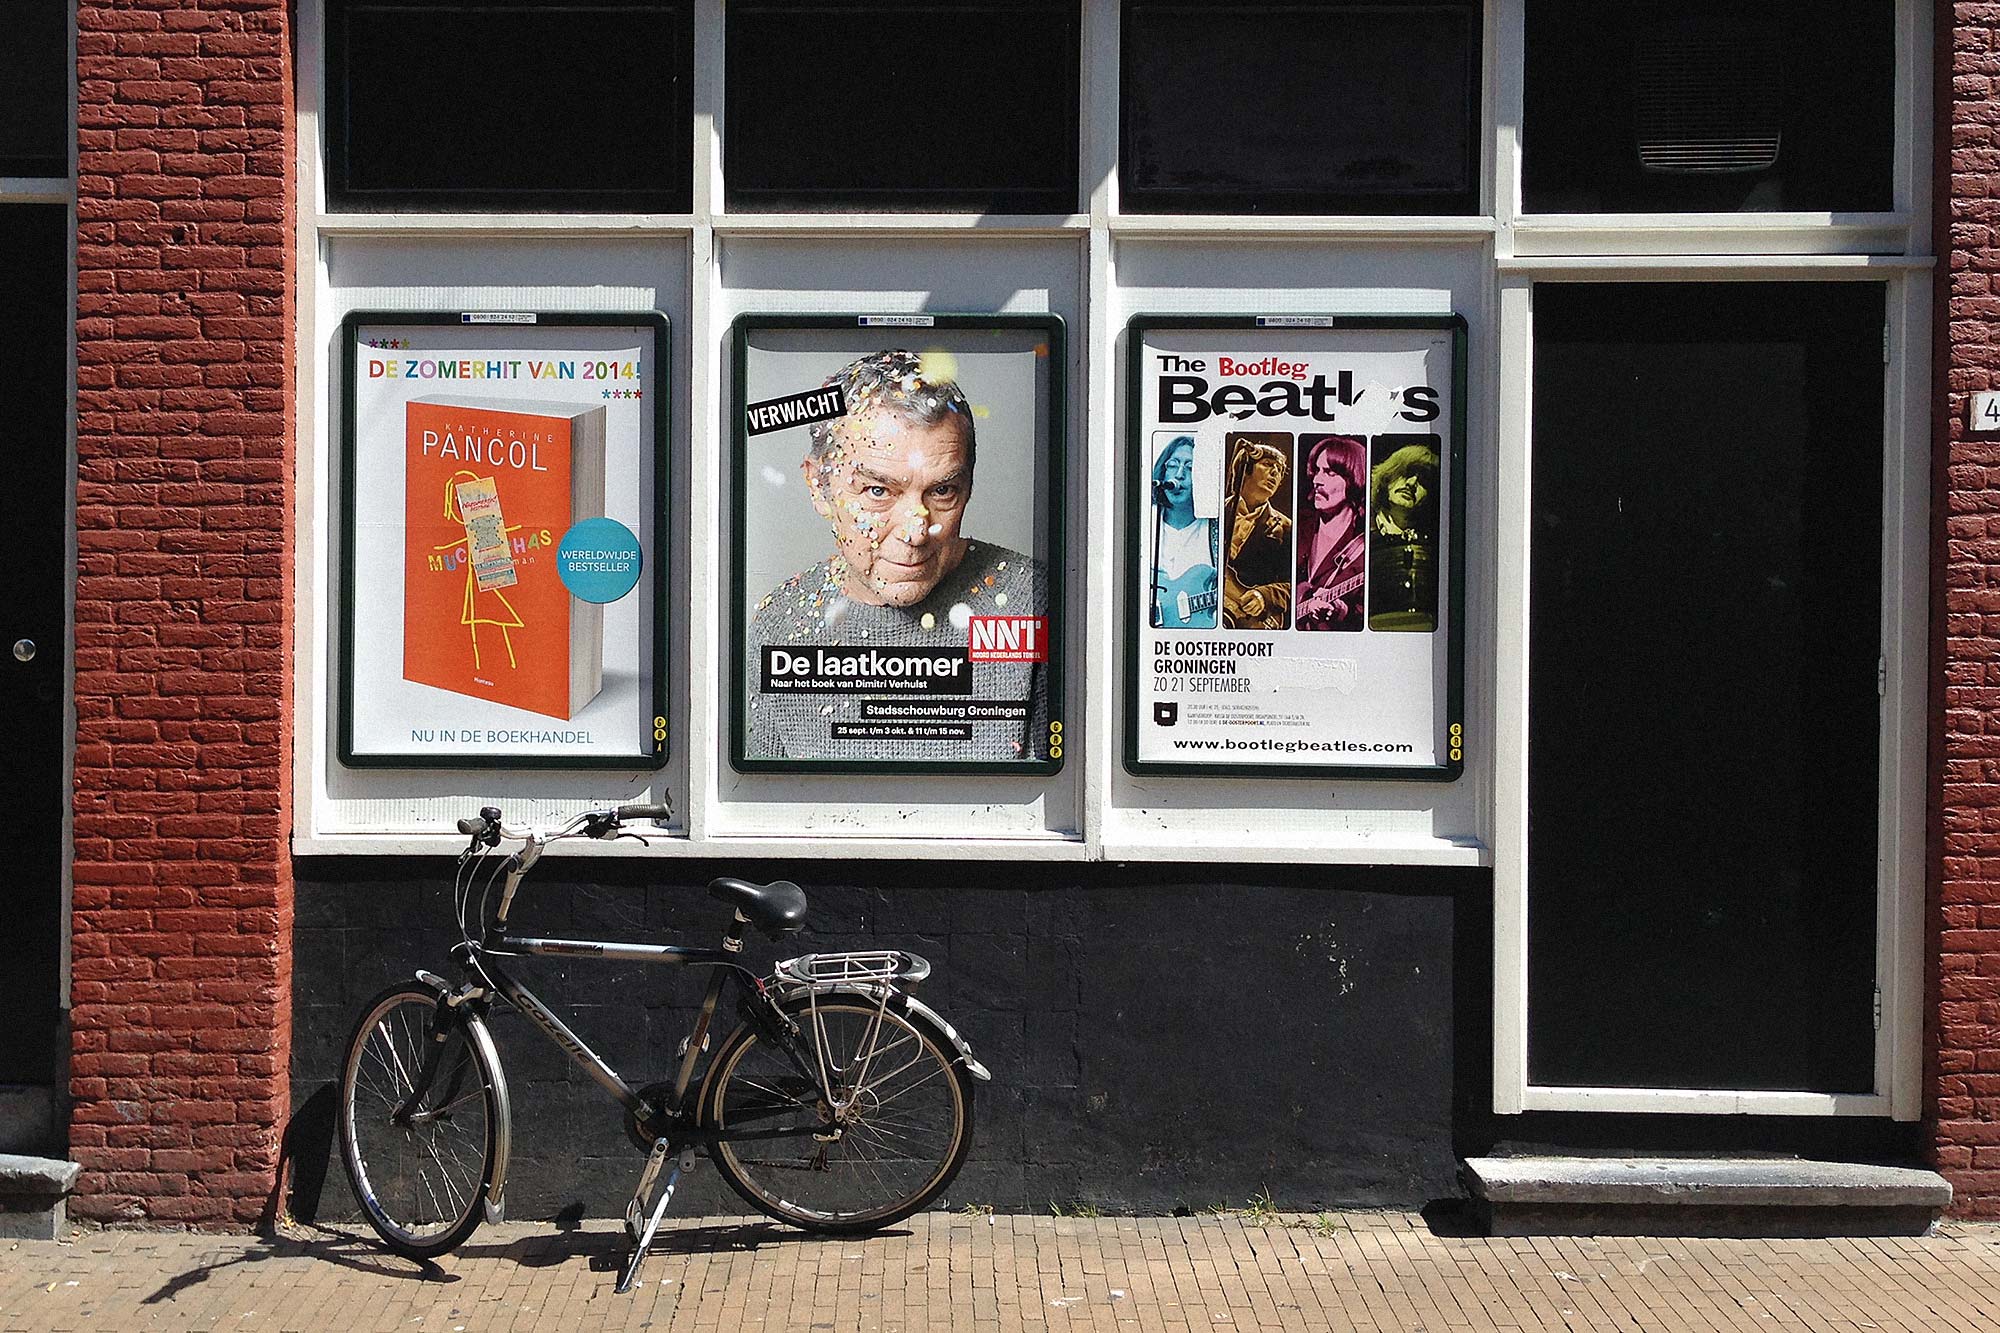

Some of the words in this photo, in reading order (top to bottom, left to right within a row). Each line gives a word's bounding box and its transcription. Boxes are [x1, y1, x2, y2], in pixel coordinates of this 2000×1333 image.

[369, 360, 398, 378] DE
[405, 360, 521, 379] ZOMERHIT
[528, 361, 575, 379] VAN
[1157, 355, 1206, 372] The
[1219, 357, 1309, 380] Bootleg
[1158, 370, 1441, 423] Beatls
[747, 391, 841, 431] VERWACHT
[445, 423, 553, 443] KATHERINE
[423, 430, 548, 471] PANCOL
[561, 550, 636, 560] WERELDWIJDE
[568, 562, 630, 572] BESTSELLER
[972, 619, 1041, 650] NNT
[1155, 641, 1170, 656] DE
[1175, 641, 1274, 657] OOSTERPOORT
[770, 650, 811, 676] De
[817, 650, 963, 677] laatkomer
[1154, 659, 1236, 674] GRONINGEN
[770, 679, 793, 688] Naar
[794, 679, 810, 688] het
[812, 679, 835, 688] boek
[855, 679, 887, 688] Dimitri
[888, 679, 928, 689] Verhulst
[1153, 677, 1167, 692] ZO
[1171, 677, 1184, 692] 21
[1189, 677, 1251, 693] SEPTEMBER
[866, 705, 966, 718] Stadsschouwburg
[967, 706, 1026, 718] Groningen
[411, 730, 435, 742] NU
[439, 730, 456, 742] IN
[460, 730, 482, 742] DE
[487, 730, 594, 743] BOEKHANDEL
[837, 727, 848, 735] 25
[849, 728, 868, 737] sept.
[869, 727, 884, 735] t/m
[885, 727, 891, 735] 3
[891, 727, 907, 735] okt.
[908, 727, 915, 735] &
[915, 727, 923, 735] 11
[924, 728, 939, 736] t/m
[939, 727, 948, 735] 15
[1173, 738, 1413, 753] www.bootlegbeatles.com
[516, 993, 592, 1064] Gazelle
